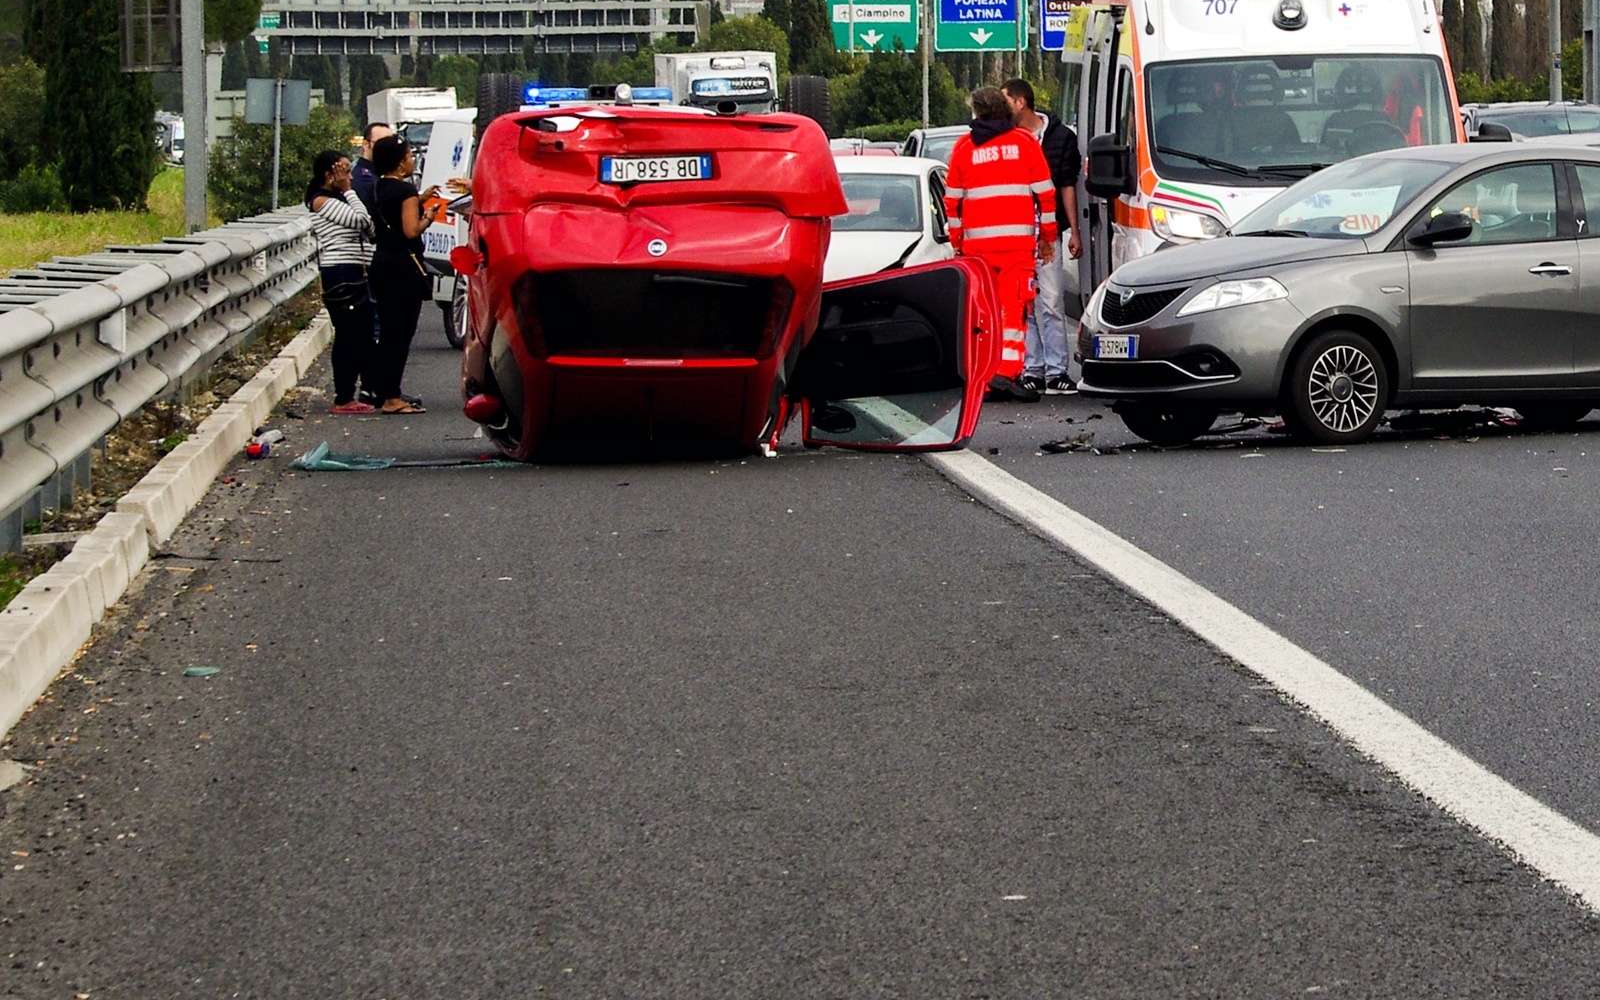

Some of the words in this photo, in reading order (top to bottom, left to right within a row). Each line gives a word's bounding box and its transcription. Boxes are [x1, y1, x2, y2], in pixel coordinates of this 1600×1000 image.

[856, 8, 906, 18] Ciampino
[959, 8, 1003, 19] LATINA
[972, 146, 999, 165] ARES
[1000, 144, 1020, 155] 118
